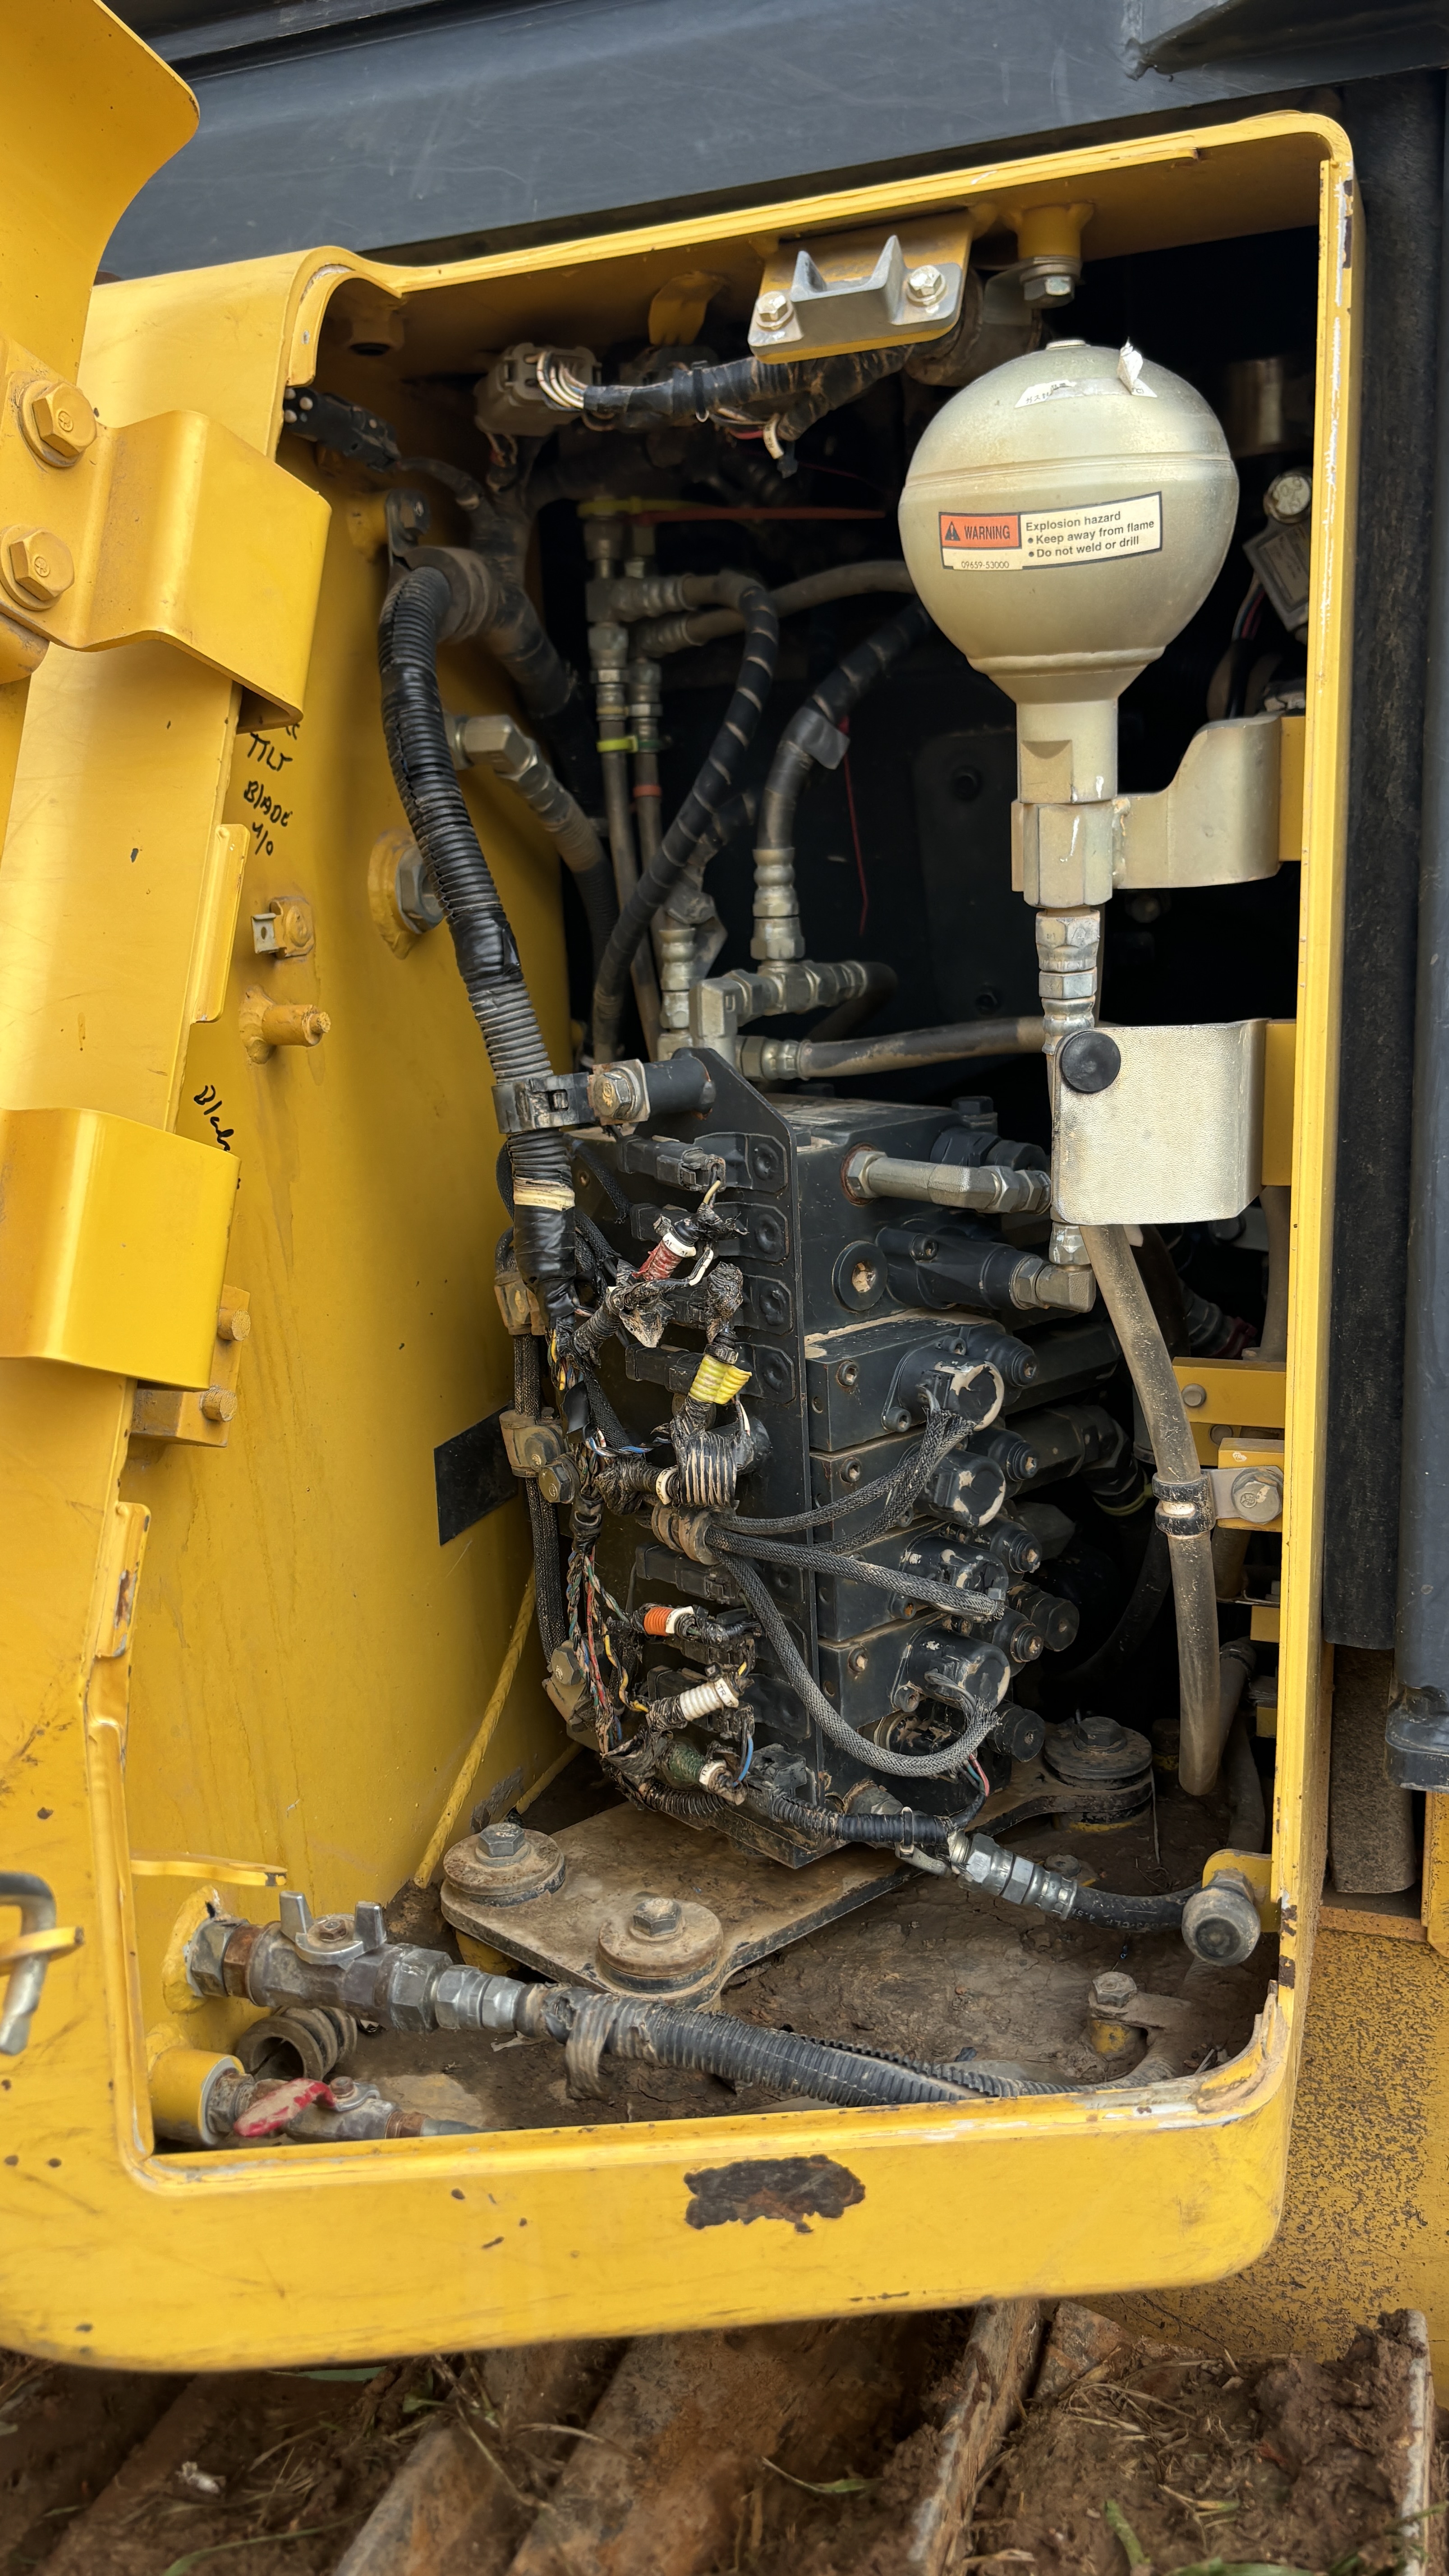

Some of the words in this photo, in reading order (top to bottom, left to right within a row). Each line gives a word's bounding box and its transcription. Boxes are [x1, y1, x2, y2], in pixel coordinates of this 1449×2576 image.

[1026, 519, 1081, 532] Explosion
[1084, 511, 1121, 525] hazard
[964, 525, 1010, 540] WARNING
[1036, 535, 1064, 545] Keep
[1067, 531, 1095, 541] away
[1099, 527, 1123, 537] from
[1127, 521, 1154, 533] flame
[1036, 549, 1052, 557] Do
[1055, 546, 1073, 556] not
[1076, 542, 1101, 553] weld
[1119, 535, 1139, 547] drill
[961, 561, 1009, 569] 09659-53000
